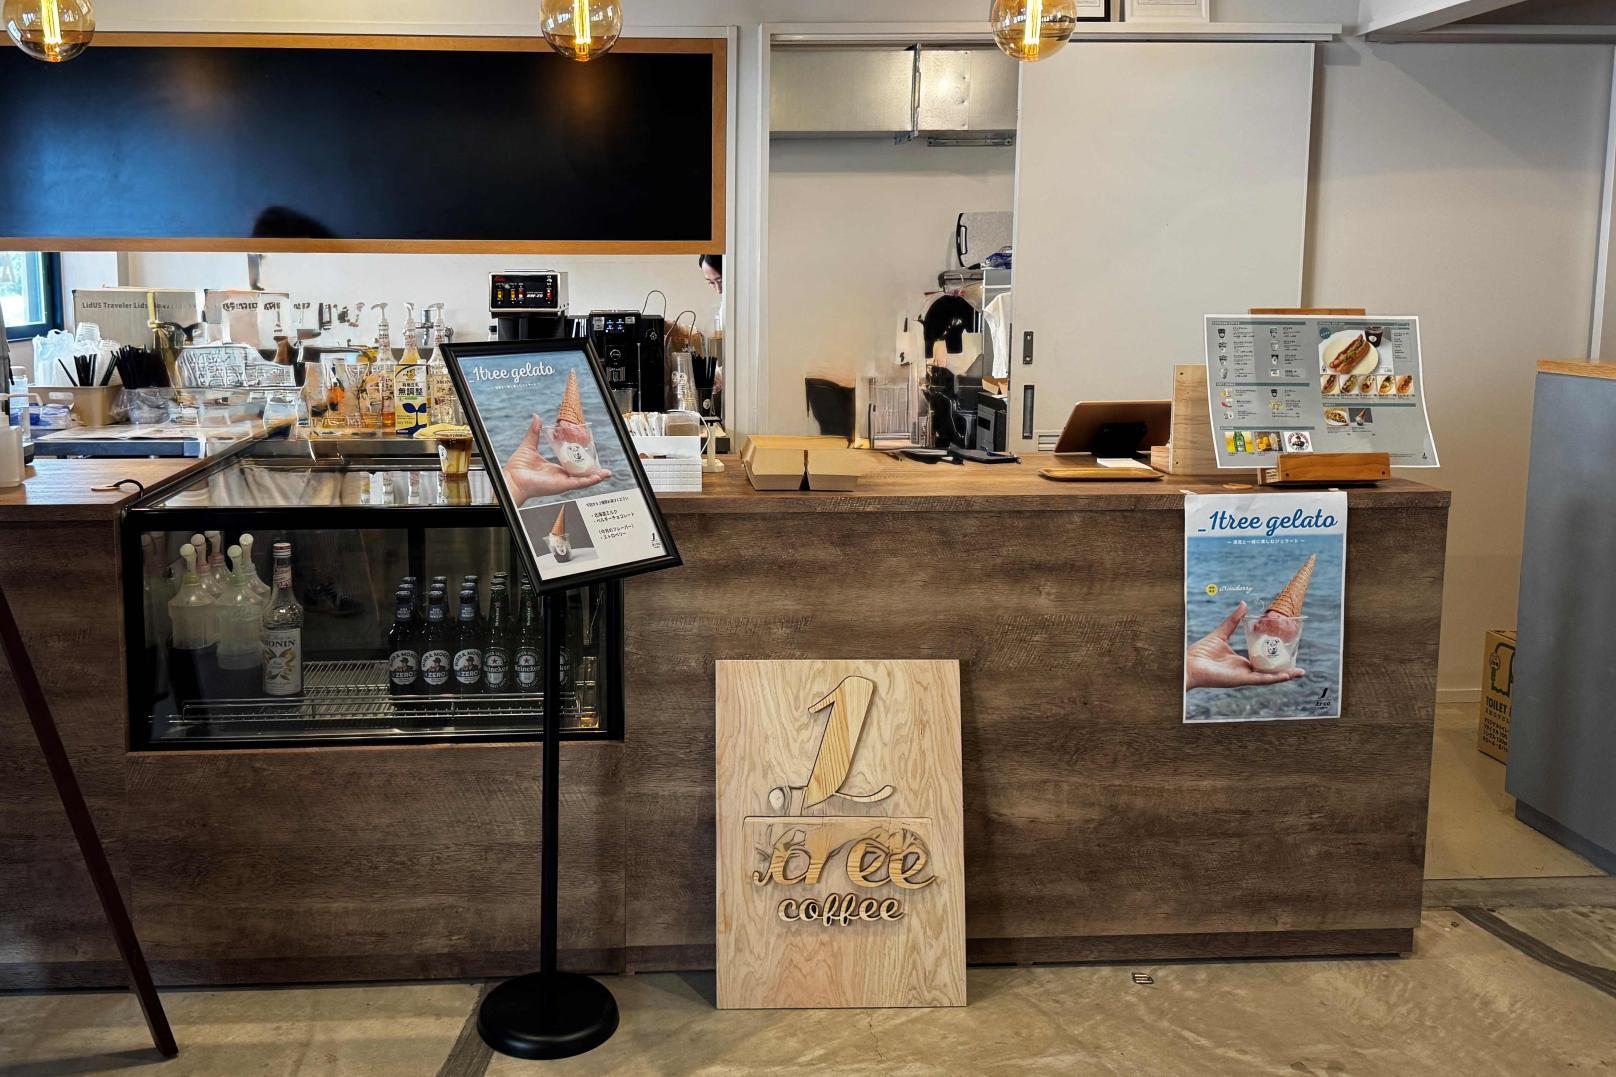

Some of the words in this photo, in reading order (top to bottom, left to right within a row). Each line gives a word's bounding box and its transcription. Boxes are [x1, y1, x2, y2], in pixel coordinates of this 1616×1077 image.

[82, 302, 102, 310] LidUS
[103, 302, 132, 310] Traveler
[511, 361, 555, 383] gelato
[398, 387, 423, 396] 無調整
[1266, 508, 1338, 536] gelato
[1486, 696, 1508, 714] TOILET
[777, 893, 905, 927] coffee
